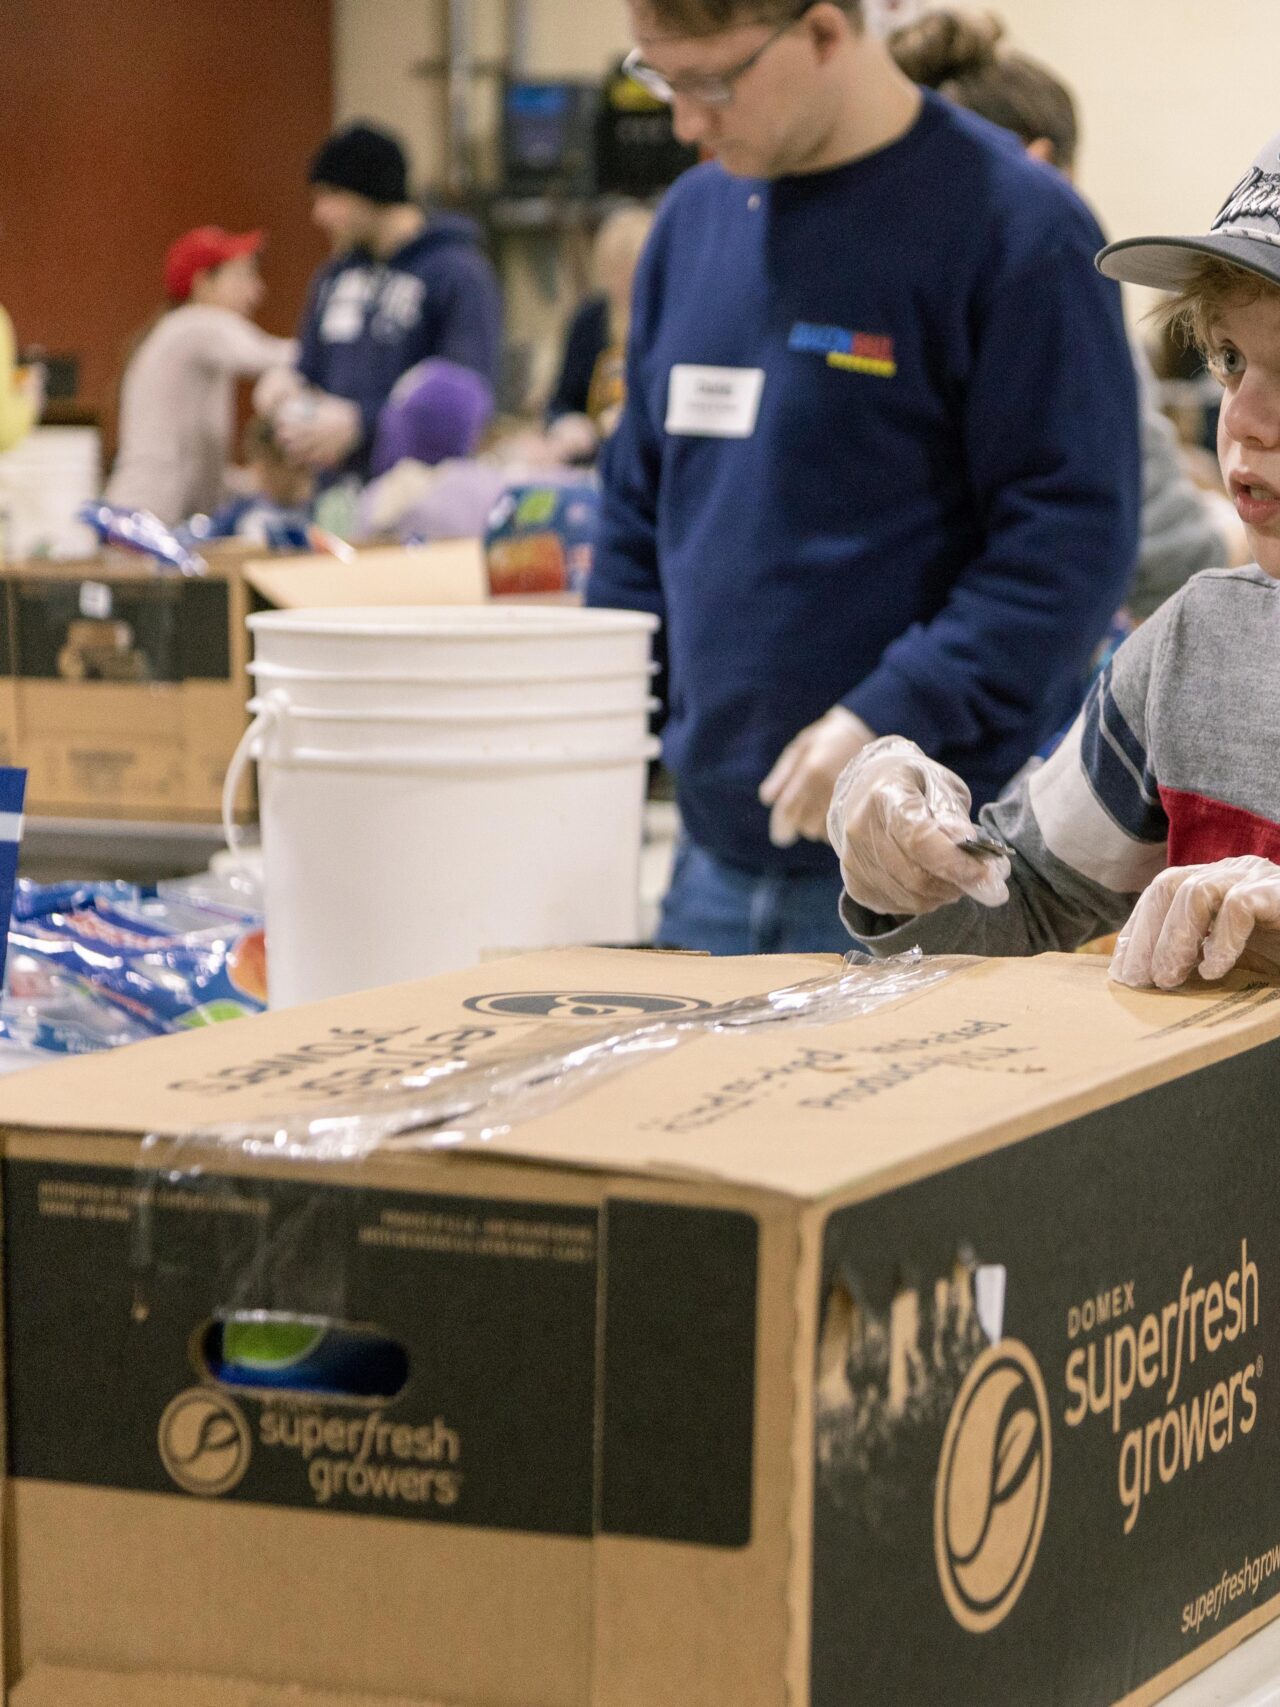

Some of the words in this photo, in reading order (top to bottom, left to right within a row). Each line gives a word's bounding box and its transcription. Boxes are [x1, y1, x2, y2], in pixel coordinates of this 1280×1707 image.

[1063, 1237, 1260, 1434] superfresh
[1067, 1280, 1136, 1339] DOMEX
[259, 1408, 462, 1466] superfresh
[308, 1456, 460, 1505] growers
